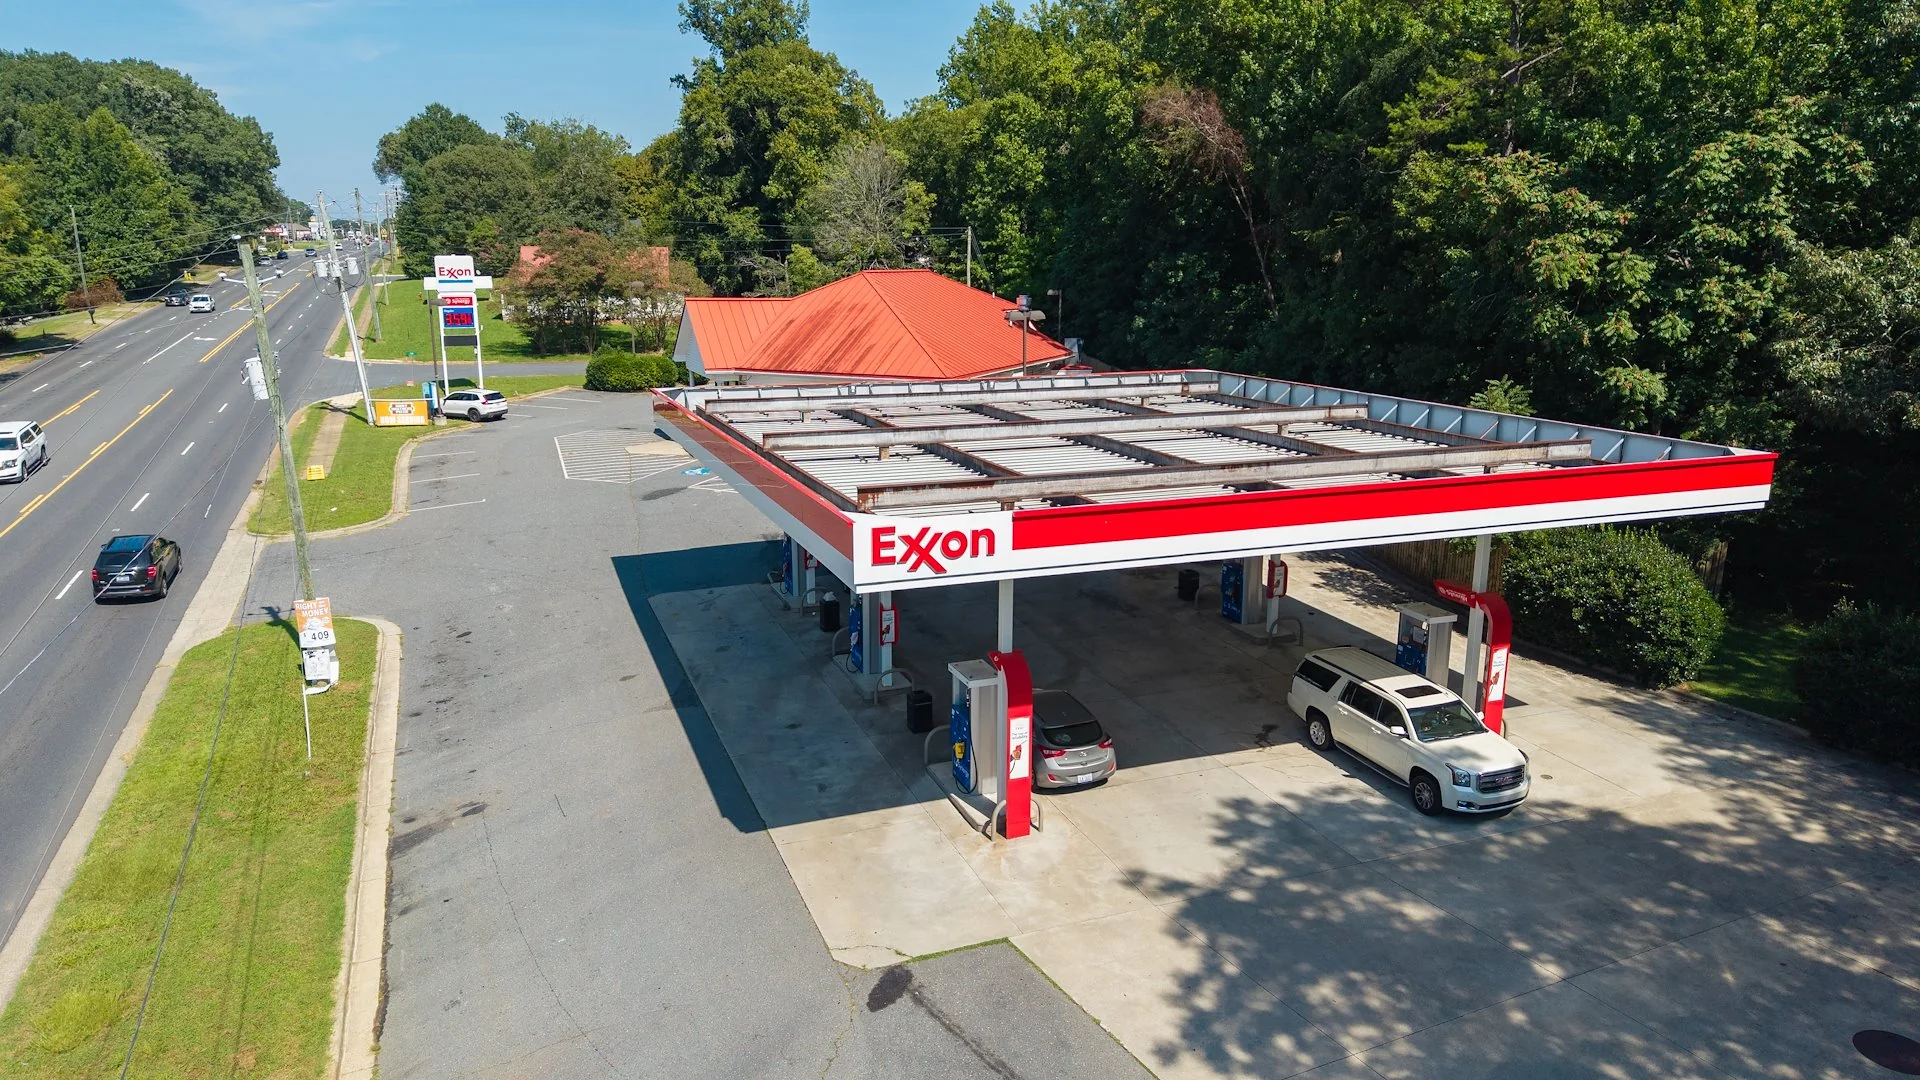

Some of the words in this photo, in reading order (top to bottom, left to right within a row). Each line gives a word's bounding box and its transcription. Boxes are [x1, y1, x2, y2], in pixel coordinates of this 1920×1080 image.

[438, 267, 472, 279] Exxon
[871, 526, 996, 574] Exxon
[295, 602, 316, 610] RIGHT
[302, 607, 329, 617] MONEY
[311, 630, 329, 641] 409
